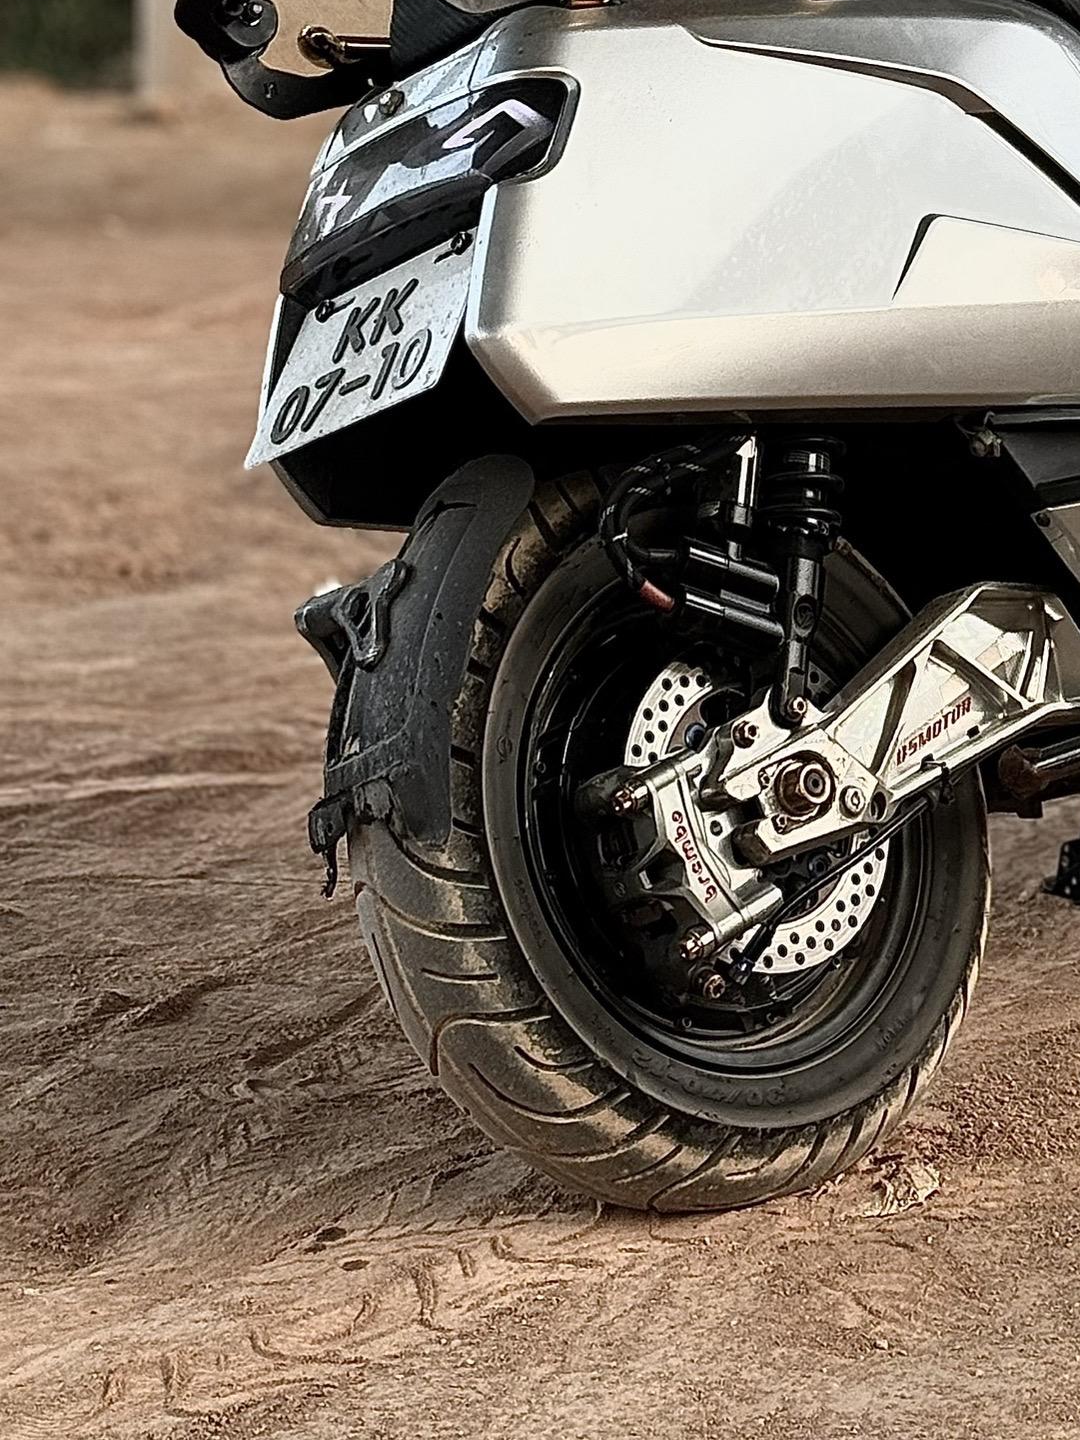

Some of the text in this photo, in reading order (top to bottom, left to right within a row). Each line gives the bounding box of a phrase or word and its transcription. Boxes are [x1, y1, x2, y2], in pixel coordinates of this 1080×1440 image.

[332, 278, 419, 364] KK
[270, 328, 432, 445] 07-10
[671, 810, 718, 904] brembo
